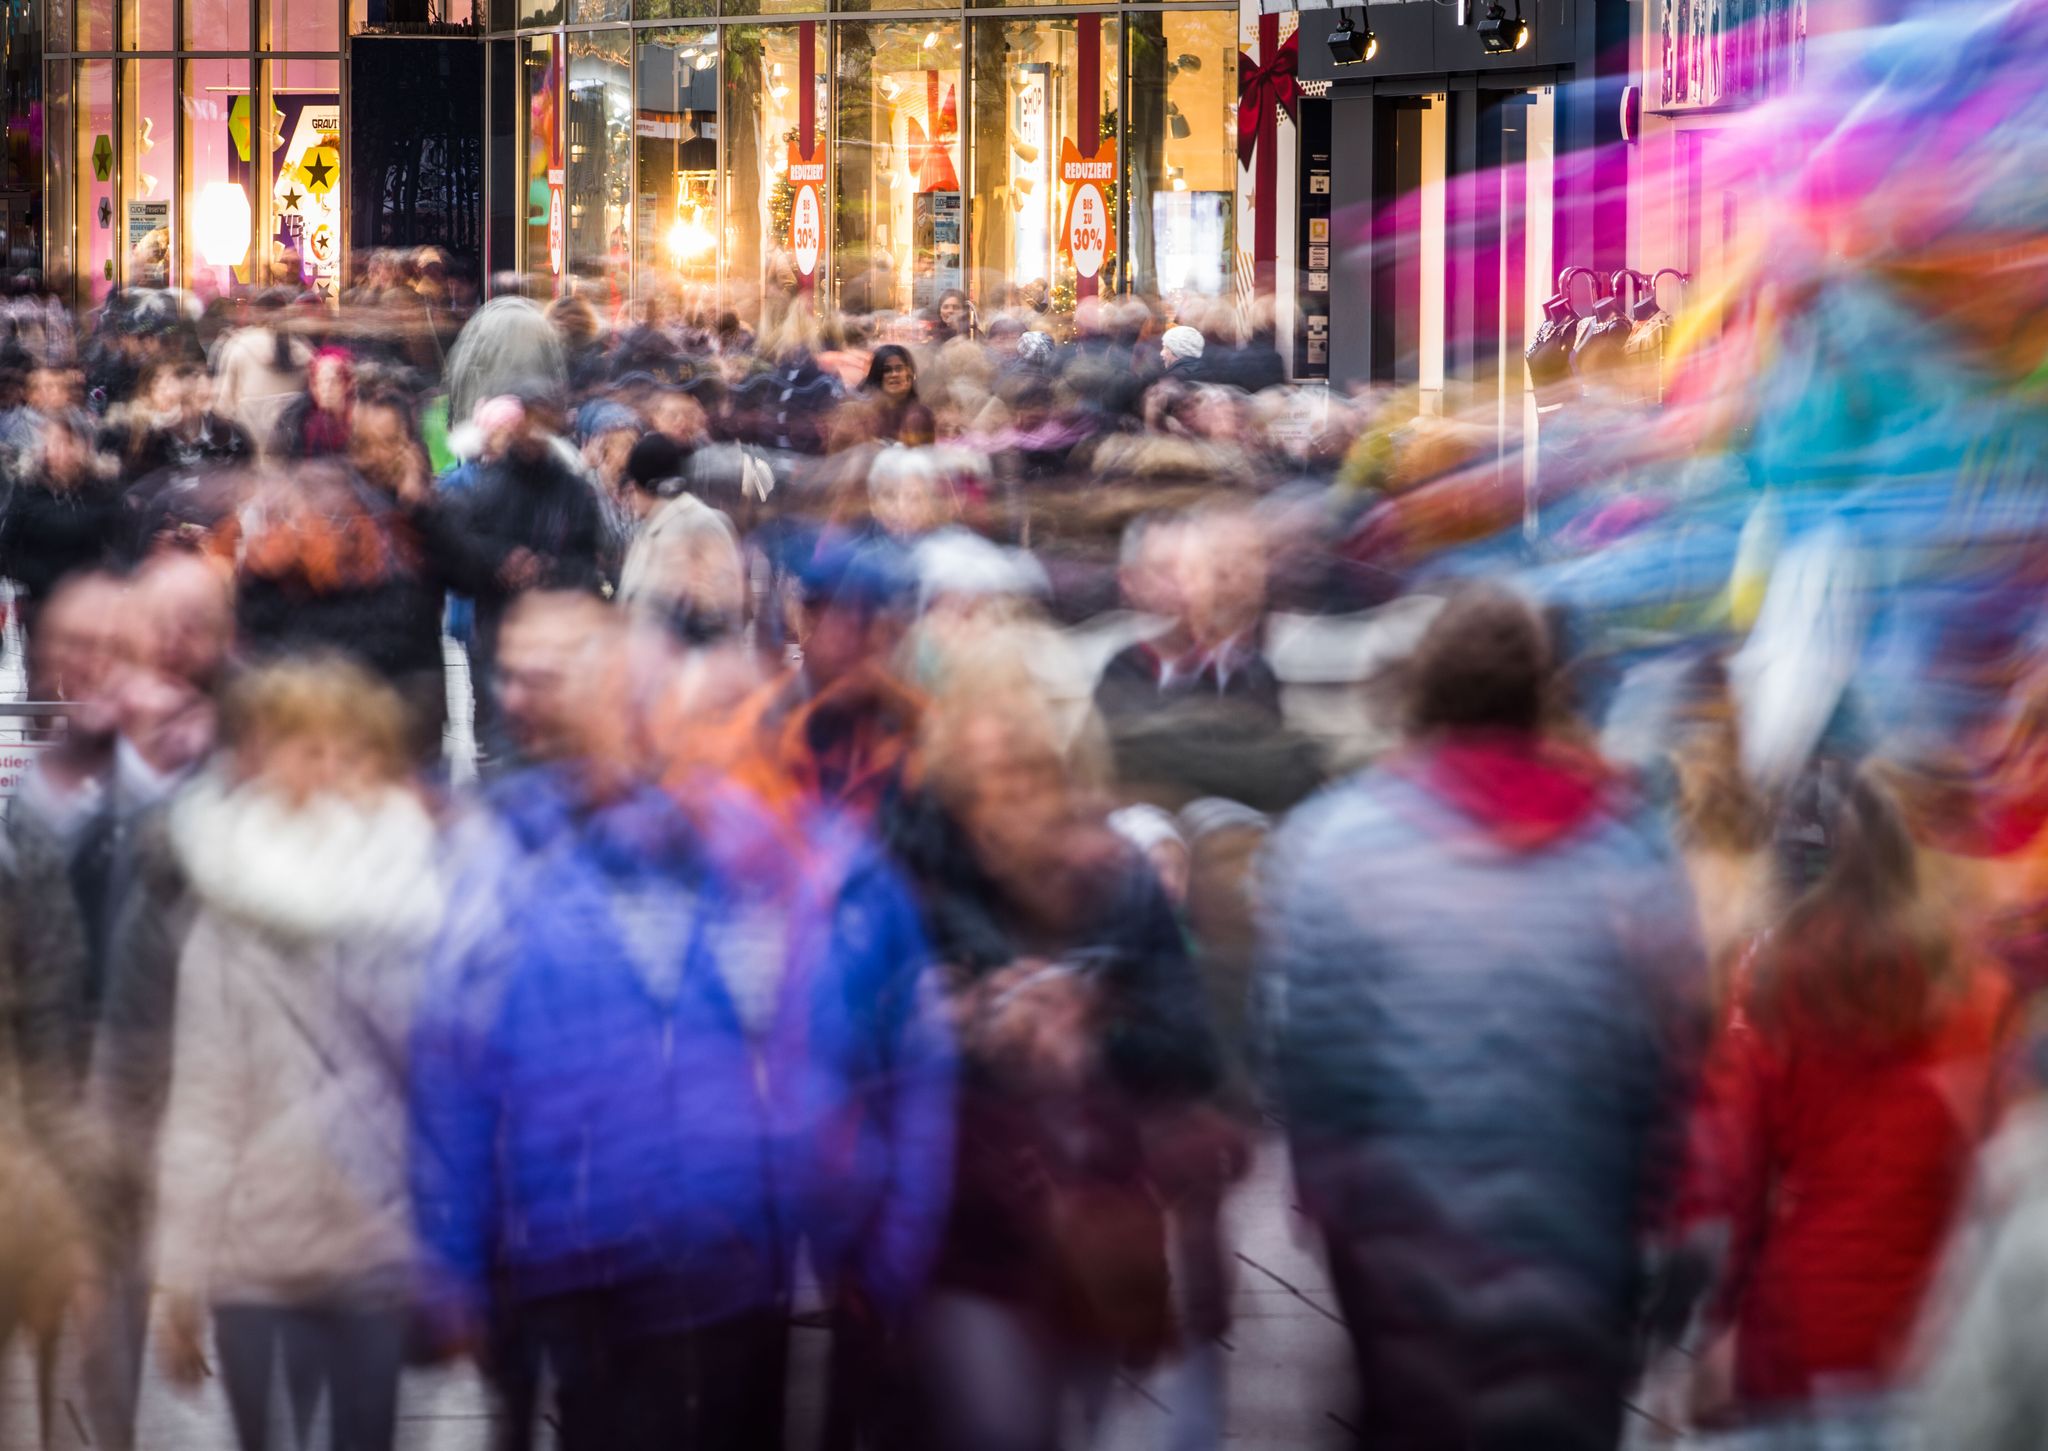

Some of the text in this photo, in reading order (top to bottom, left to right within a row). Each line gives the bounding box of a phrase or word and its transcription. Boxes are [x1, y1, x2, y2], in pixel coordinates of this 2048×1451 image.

[790, 164, 824, 180] REDUZIERT
[1064, 162, 1113, 179] REDUZIERT
[1083, 199, 1093, 210] BIS
[1083, 213, 1092, 224] ZU
[797, 228, 817, 249] 30%
[1074, 228, 1103, 251] 30%
